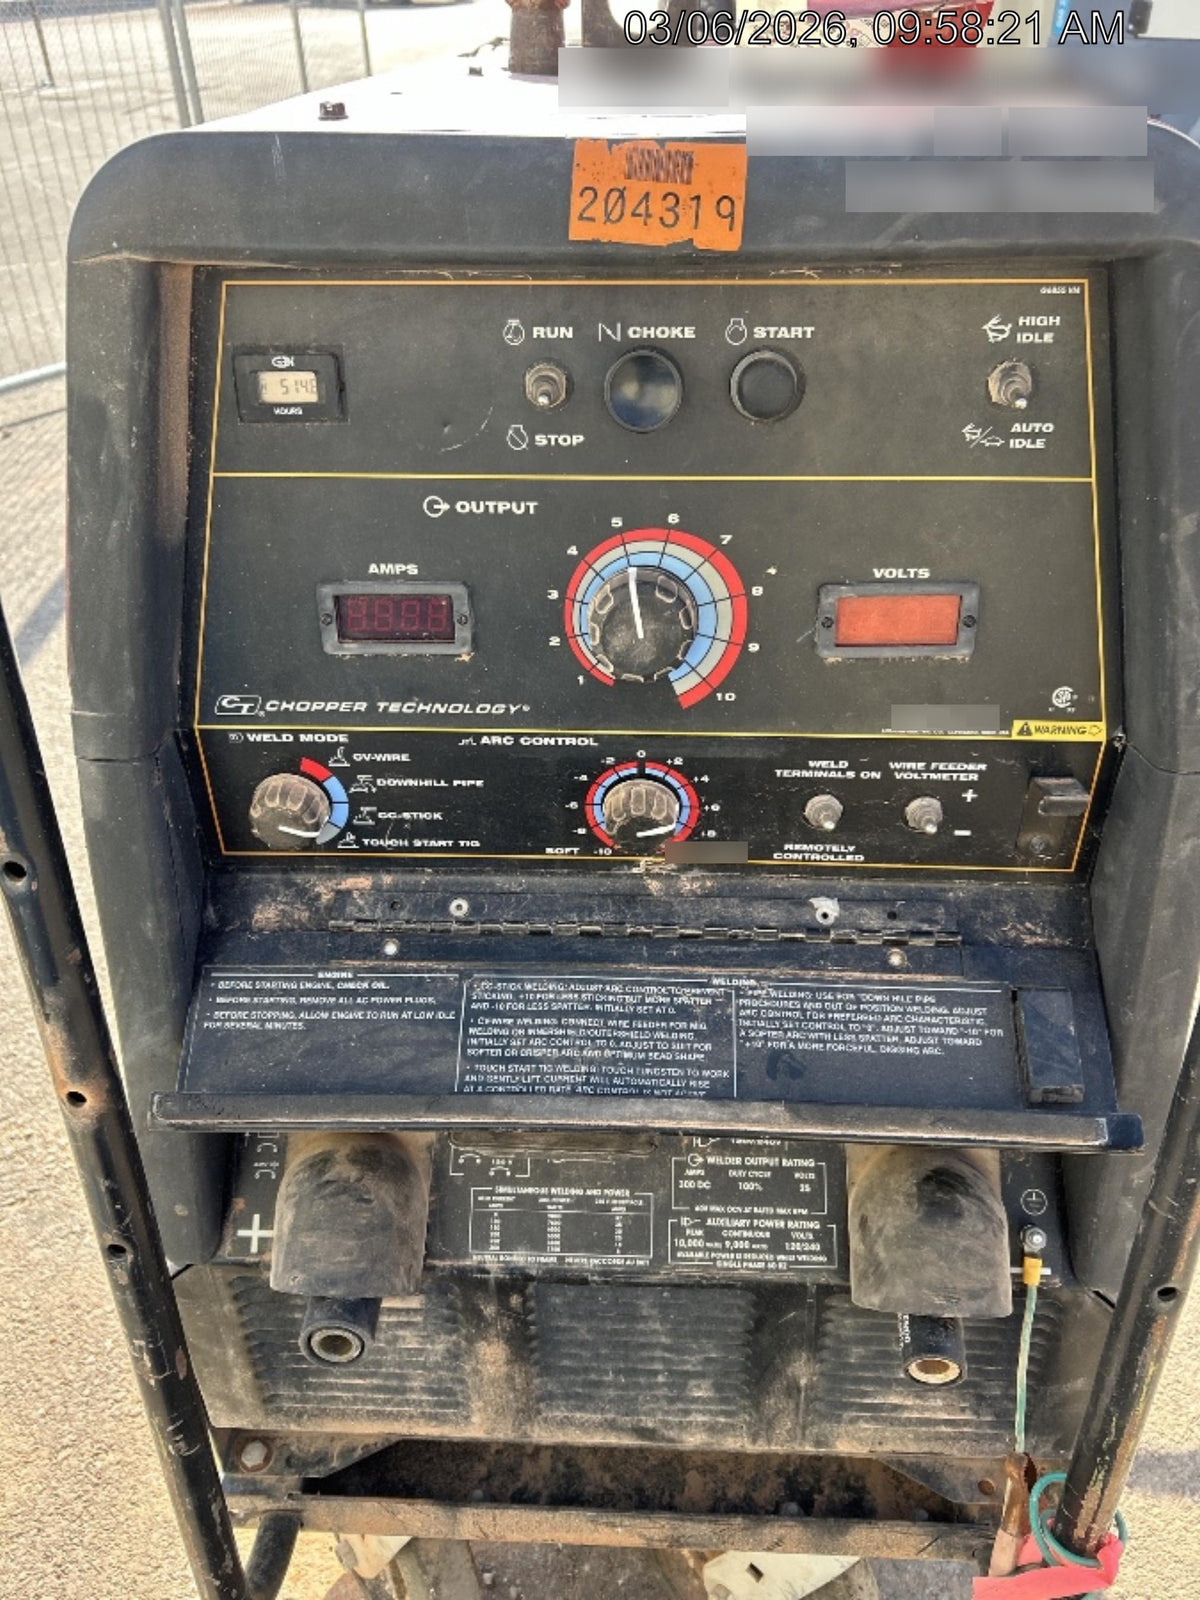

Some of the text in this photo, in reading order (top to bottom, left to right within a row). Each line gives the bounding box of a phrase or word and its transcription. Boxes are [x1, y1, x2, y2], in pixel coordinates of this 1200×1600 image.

[577, 186, 736, 231] 204319
[1019, 316, 1061, 326] HIGH
[532, 326, 574, 338] RUN
[627, 326, 696, 338] CHOKE
[753, 326, 815, 338] START
[1016, 332, 1055, 343] IDLE
[1010, 422, 1054, 433] AUTO
[534, 434, 585, 447] STOP
[1009, 438, 1047, 449] IDLE
[455, 501, 538, 515] OUTPUT
[611, 517, 623, 527] 5
[667, 514, 679, 524] 6
[720, 535, 732, 545] 7
[566, 545, 578, 555] 4
[368, 563, 419, 575] AMPS
[873, 568, 931, 579] VOLTS
[547, 590, 558, 599] 3
[751, 586, 763, 596] 8
[549, 637, 560, 646] 2
[748, 643, 760, 652] 9
[577, 675, 584, 684] 1
[716, 693, 736, 702] 10
[265, 701, 368, 712] CHOPPER
[1034, 725, 1088, 735] WARNING
[246, 733, 349, 743] WELD MODE
[480, 735, 599, 746] ARC CONTROL
[665, 757, 683, 766] +2
[808, 760, 849, 769] WELD
[889, 761, 987, 772] WIRE FEEDER
[693, 774, 710, 783] +4
[774, 769, 881, 780] TERMINALS ON
[894, 771, 980, 782] VOLTMETER
[376, 778, 485, 787] DOWNHILL PIPE
[377, 811, 443, 821] CC-STICK
[362, 838, 481, 848] TOUCH START TIG
[783, 843, 856, 853] REMOTELY
[545, 847, 612, 855] SOFT -10
[773, 853, 865, 863] CONTROLLED
